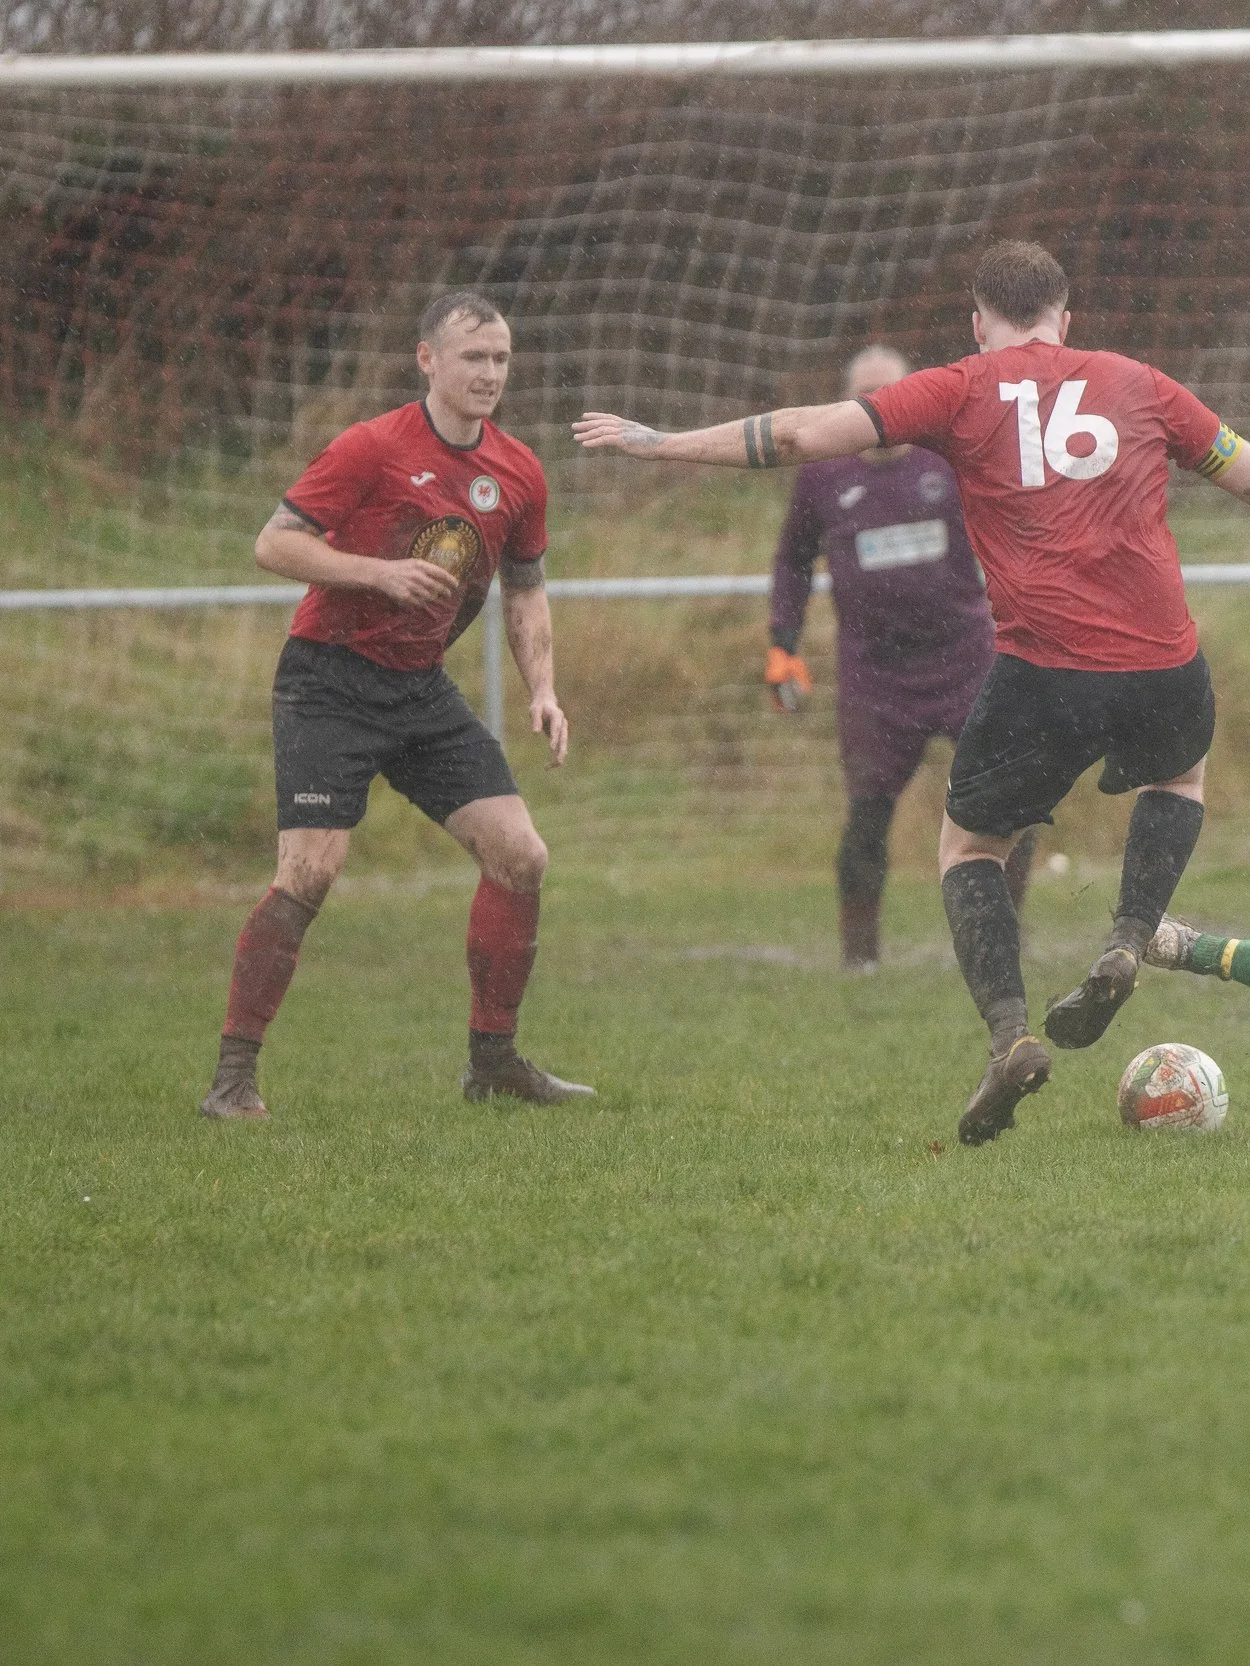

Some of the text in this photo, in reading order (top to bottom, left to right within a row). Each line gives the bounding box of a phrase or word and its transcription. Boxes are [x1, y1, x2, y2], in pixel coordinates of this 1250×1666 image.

[998, 379, 1118, 487] 16
[1215, 431, 1236, 457] C
[294, 792, 330, 805] ICON
